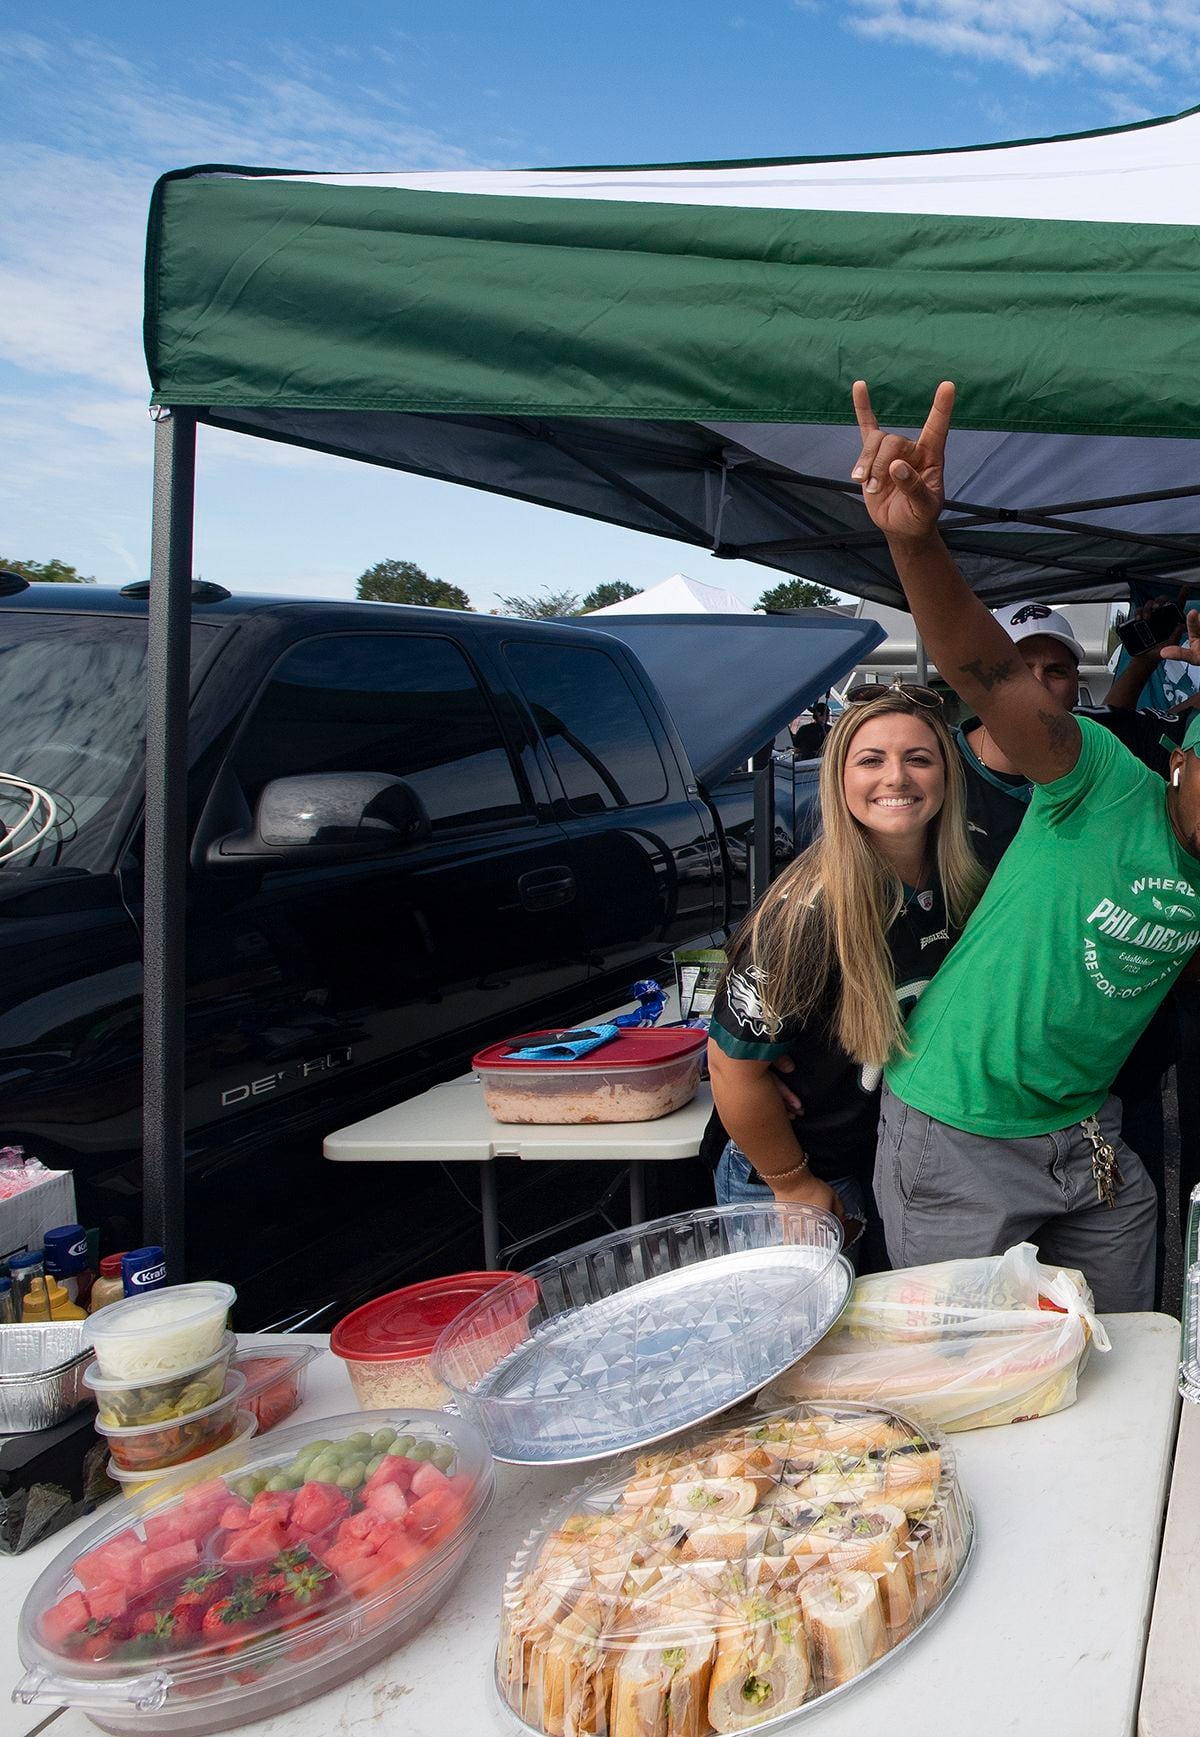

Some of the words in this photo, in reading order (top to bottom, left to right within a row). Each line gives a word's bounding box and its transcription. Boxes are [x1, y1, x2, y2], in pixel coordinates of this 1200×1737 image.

[1131, 877, 1196, 895] WHERE
[1084, 937, 1098, 970] ARE
[1091, 971, 1116, 998] FOR
